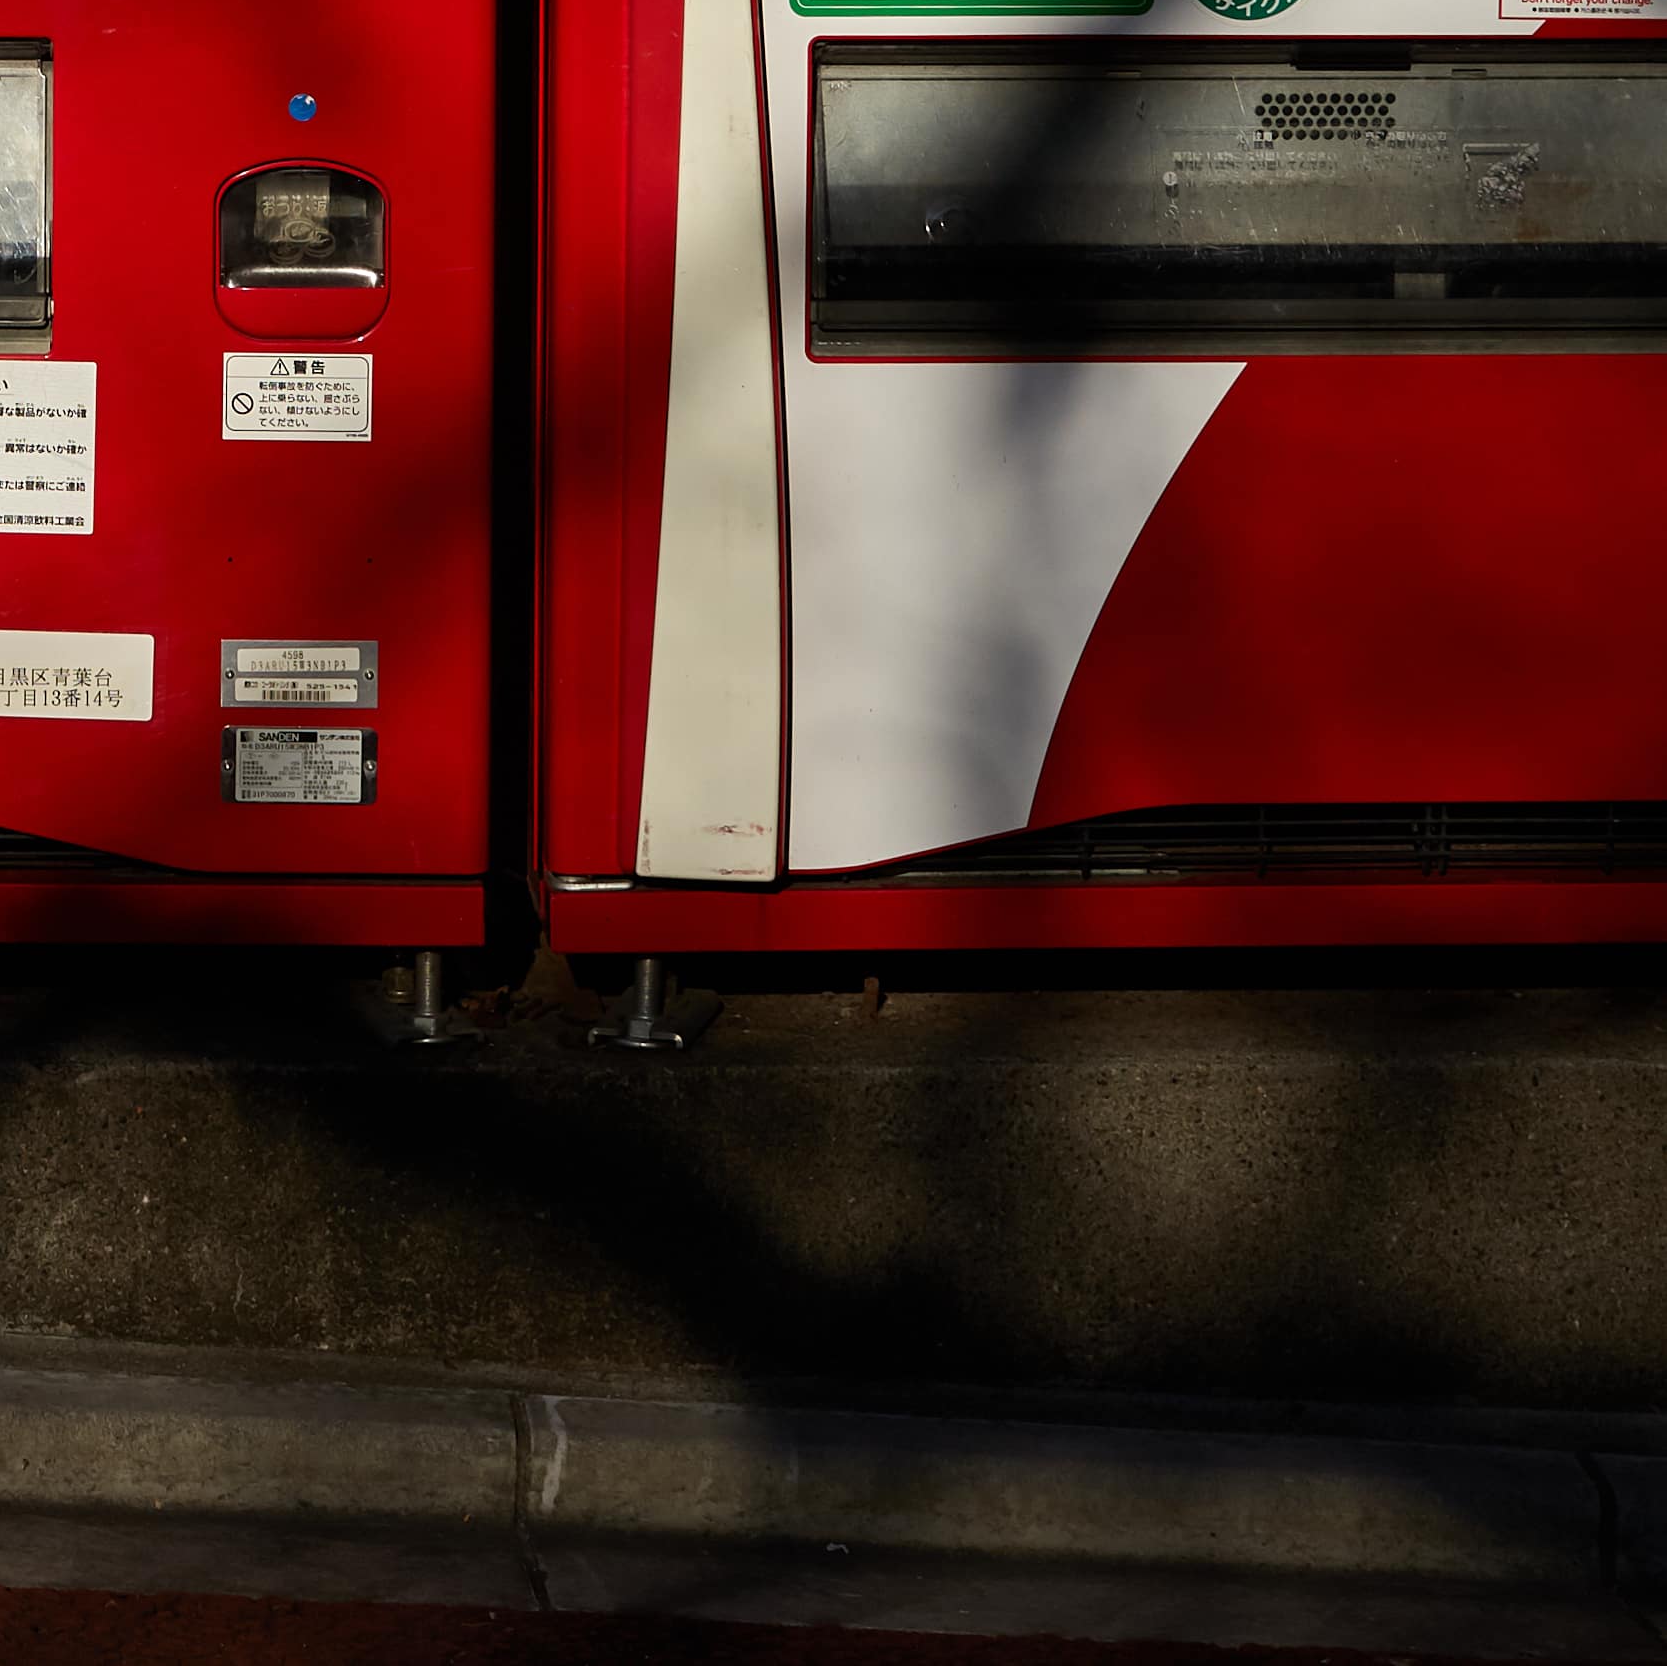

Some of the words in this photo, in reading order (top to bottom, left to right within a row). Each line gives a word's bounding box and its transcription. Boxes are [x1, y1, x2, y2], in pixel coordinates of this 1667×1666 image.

[294, 360, 325, 375] 警告
[259, 418, 309, 427] てください。
[259, 732, 300, 742] SANDEN
